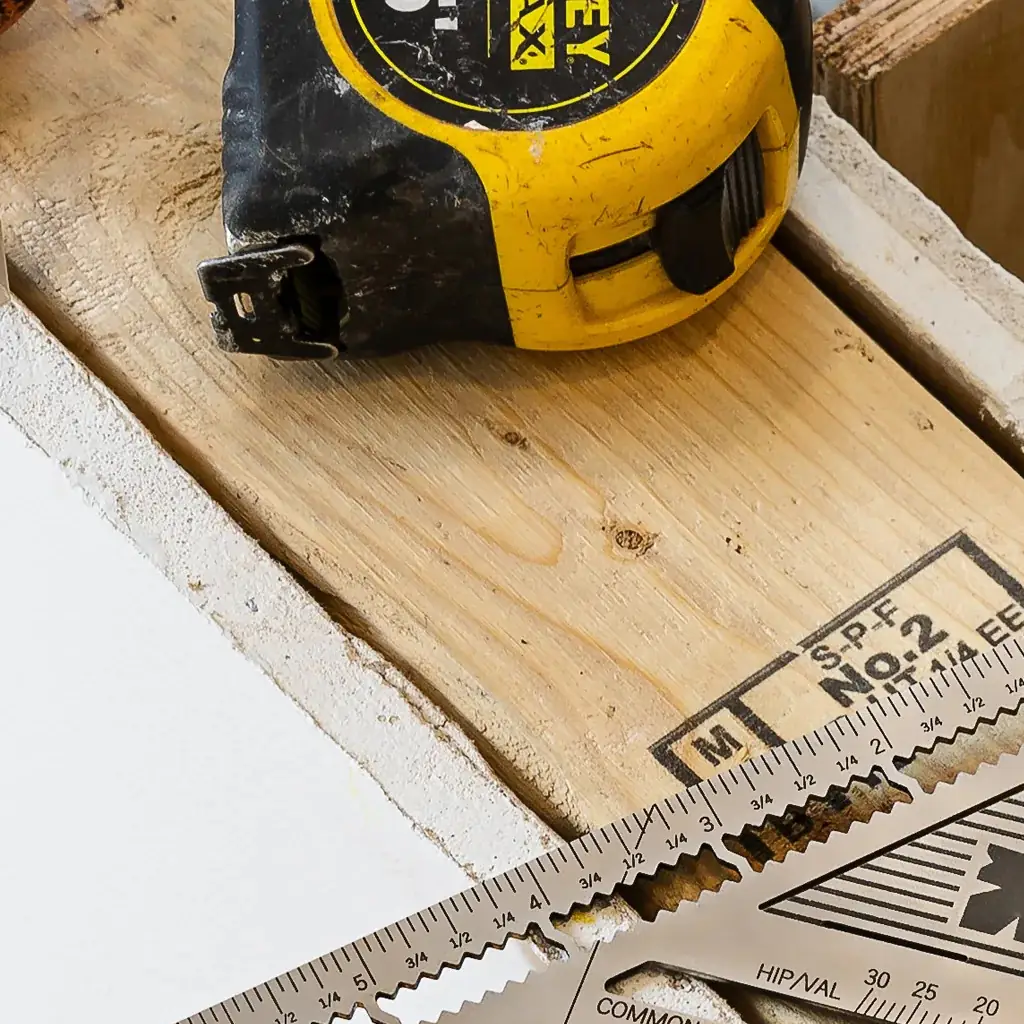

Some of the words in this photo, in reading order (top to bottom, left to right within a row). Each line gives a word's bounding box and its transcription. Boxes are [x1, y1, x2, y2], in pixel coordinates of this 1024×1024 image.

[810, 598, 899, 671] S-P-F
[691, 724, 743, 767] M
[318, 991, 341, 1009] 1/4
[352, 973, 368, 991] 5
[405, 951, 429, 969] 3/4
[449, 931, 473, 949] 1/2
[492, 911, 516, 929] 1/4
[530, 894, 543, 910] 4
[578, 872, 602, 889] 3/4
[622, 852, 646, 870] 1/2
[665, 832, 688, 851] 1/4
[698, 816, 715, 833] 3
[750, 793, 774, 811] 3/4
[793, 774, 817, 792] 1/2
[836, 755, 859, 772] 1/4
[870, 738, 886, 755] 2
[920, 716, 943, 733] 3/4
[963, 697, 986, 714] 1/2
[756, 963, 841, 1001] HIP/VAL
[863, 968, 891, 989] 30
[911, 980, 939, 1001] 25
[972, 996, 1000, 1016] 20
